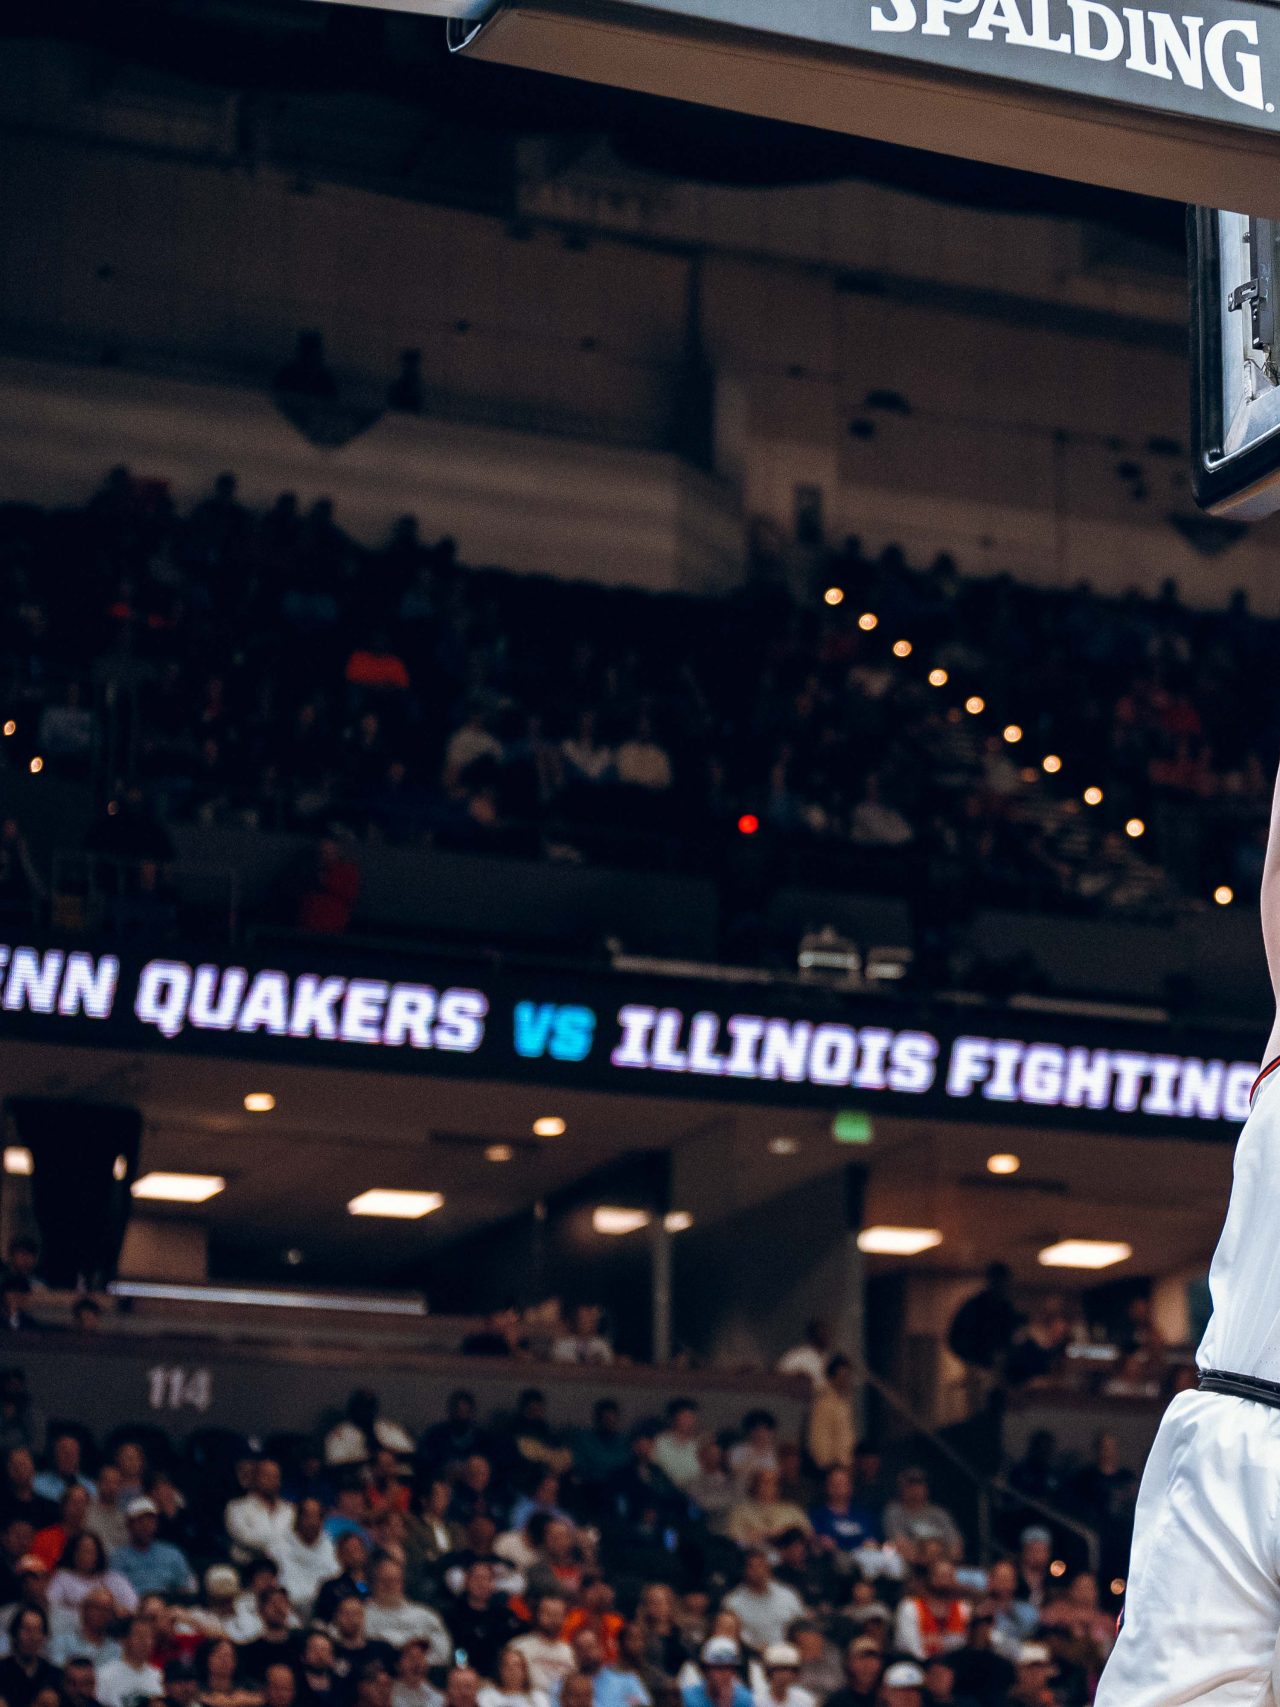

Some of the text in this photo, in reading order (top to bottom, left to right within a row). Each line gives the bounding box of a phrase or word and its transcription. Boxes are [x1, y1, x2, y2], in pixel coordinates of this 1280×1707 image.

[0, 944, 1260, 1121] NN QUAKERS VS ILLINOIS FIGHTING
[149, 1366, 211, 1412] 114
